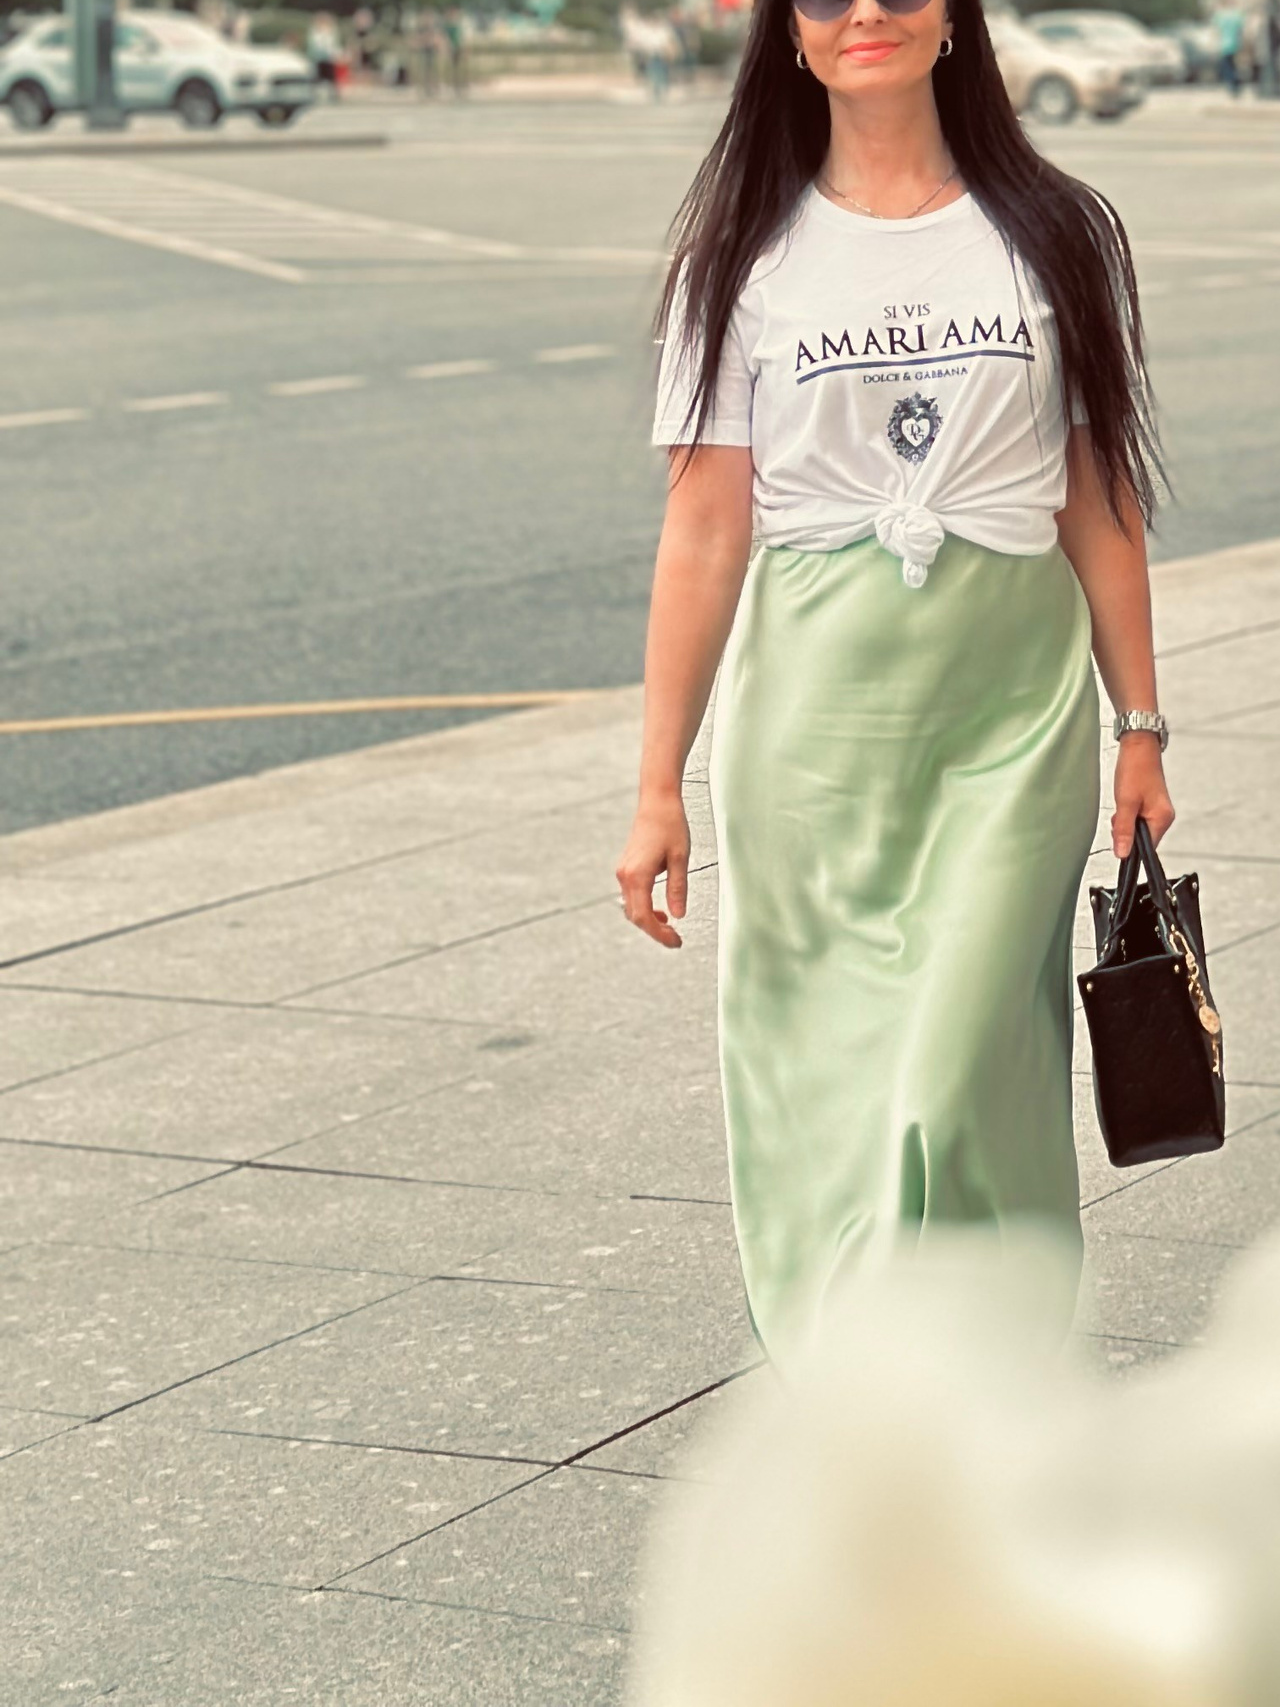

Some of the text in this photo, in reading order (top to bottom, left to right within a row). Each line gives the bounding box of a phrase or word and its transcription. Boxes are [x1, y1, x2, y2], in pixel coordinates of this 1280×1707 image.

[884, 303, 931, 319] SI VIS
[795, 313, 1034, 371] AMARI AMA
[863, 367, 968, 384] DOLCE & GABBANA
